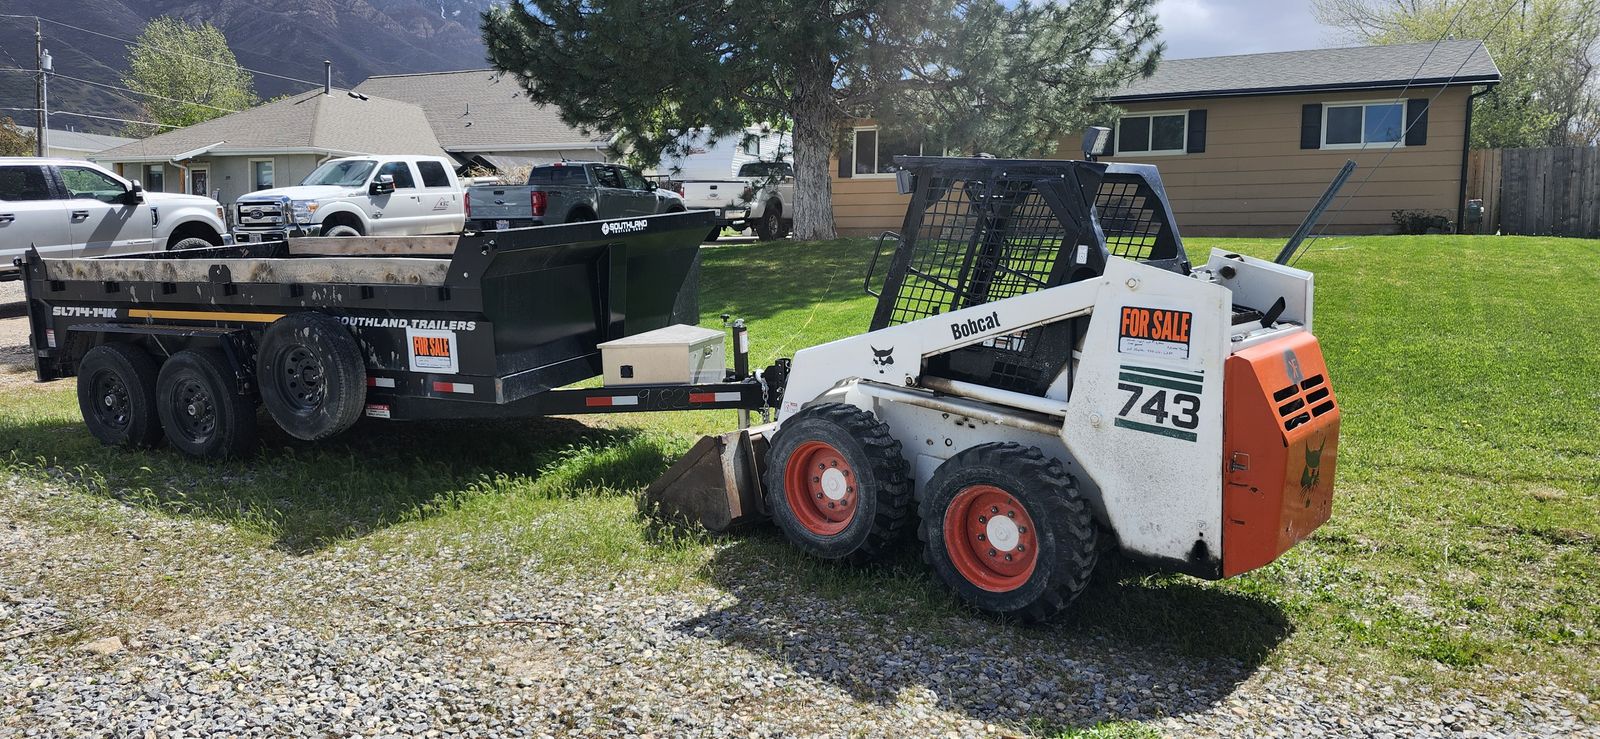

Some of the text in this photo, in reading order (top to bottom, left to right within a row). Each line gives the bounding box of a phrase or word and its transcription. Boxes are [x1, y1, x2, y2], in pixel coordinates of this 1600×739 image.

[609, 220, 648, 231] SOUTHLAND
[52, 306, 118, 318] SL714-14K
[411, 319, 476, 331] TRAILERS
[950, 311, 1001, 341] Bobcat
[1121, 307, 1190, 343] FOR SALE
[413, 335, 450, 357] FOR SALE
[1117, 382, 1201, 430] 743
